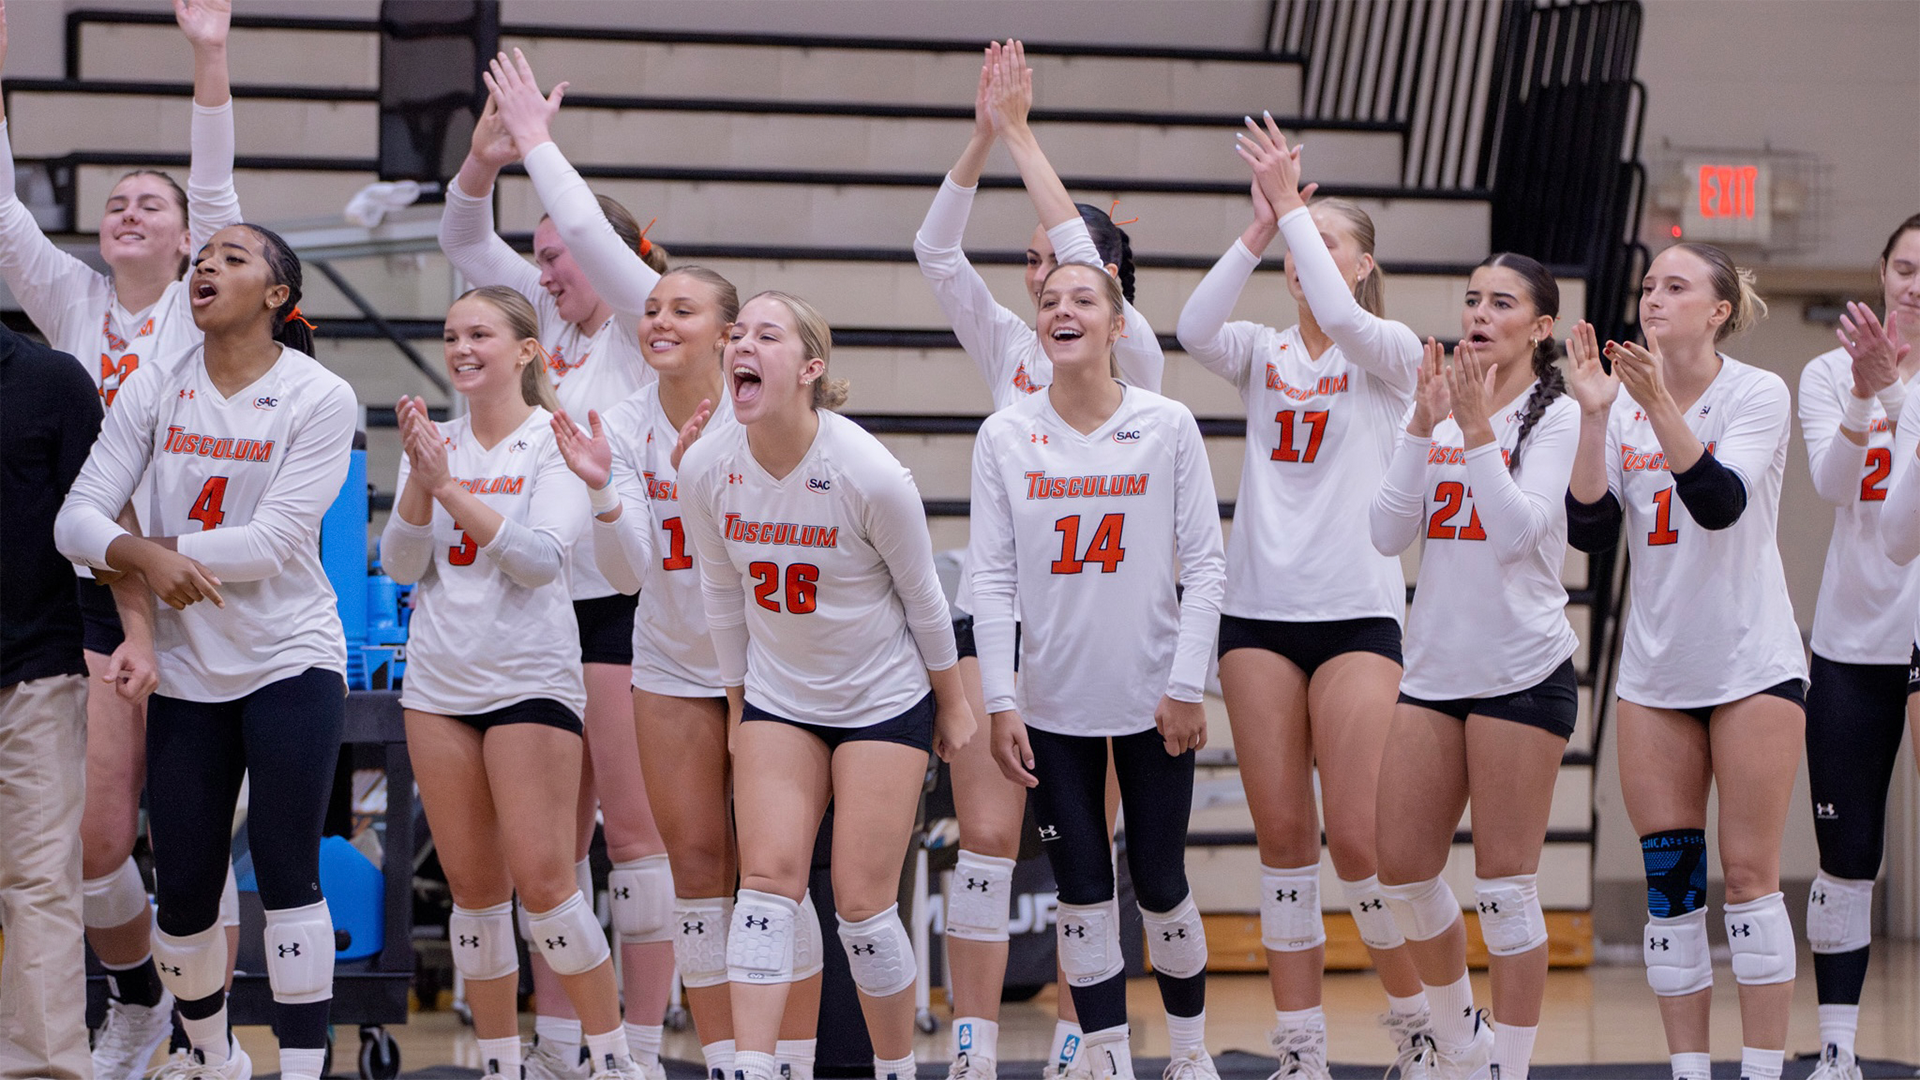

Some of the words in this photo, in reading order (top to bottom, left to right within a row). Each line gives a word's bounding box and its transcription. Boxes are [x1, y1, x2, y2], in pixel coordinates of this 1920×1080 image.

[1699, 165, 1758, 219] EXIT
[257, 397, 278, 408] SAC
[163, 425, 275, 462] TUSCULUM
[1116, 430, 1140, 440] SAC
[1270, 409, 1330, 463] 17
[809, 478, 831, 490] SAC
[1024, 471, 1150, 500] TUSCULUM
[1860, 447, 1891, 501] 2
[187, 476, 229, 531] 4
[724, 512, 839, 548] TUSCULUM
[1647, 485, 1679, 546] 1
[448, 521, 478, 566] 3
[662, 516, 693, 571] 1
[1051, 513, 1126, 574] 14
[749, 561, 820, 614] 26
